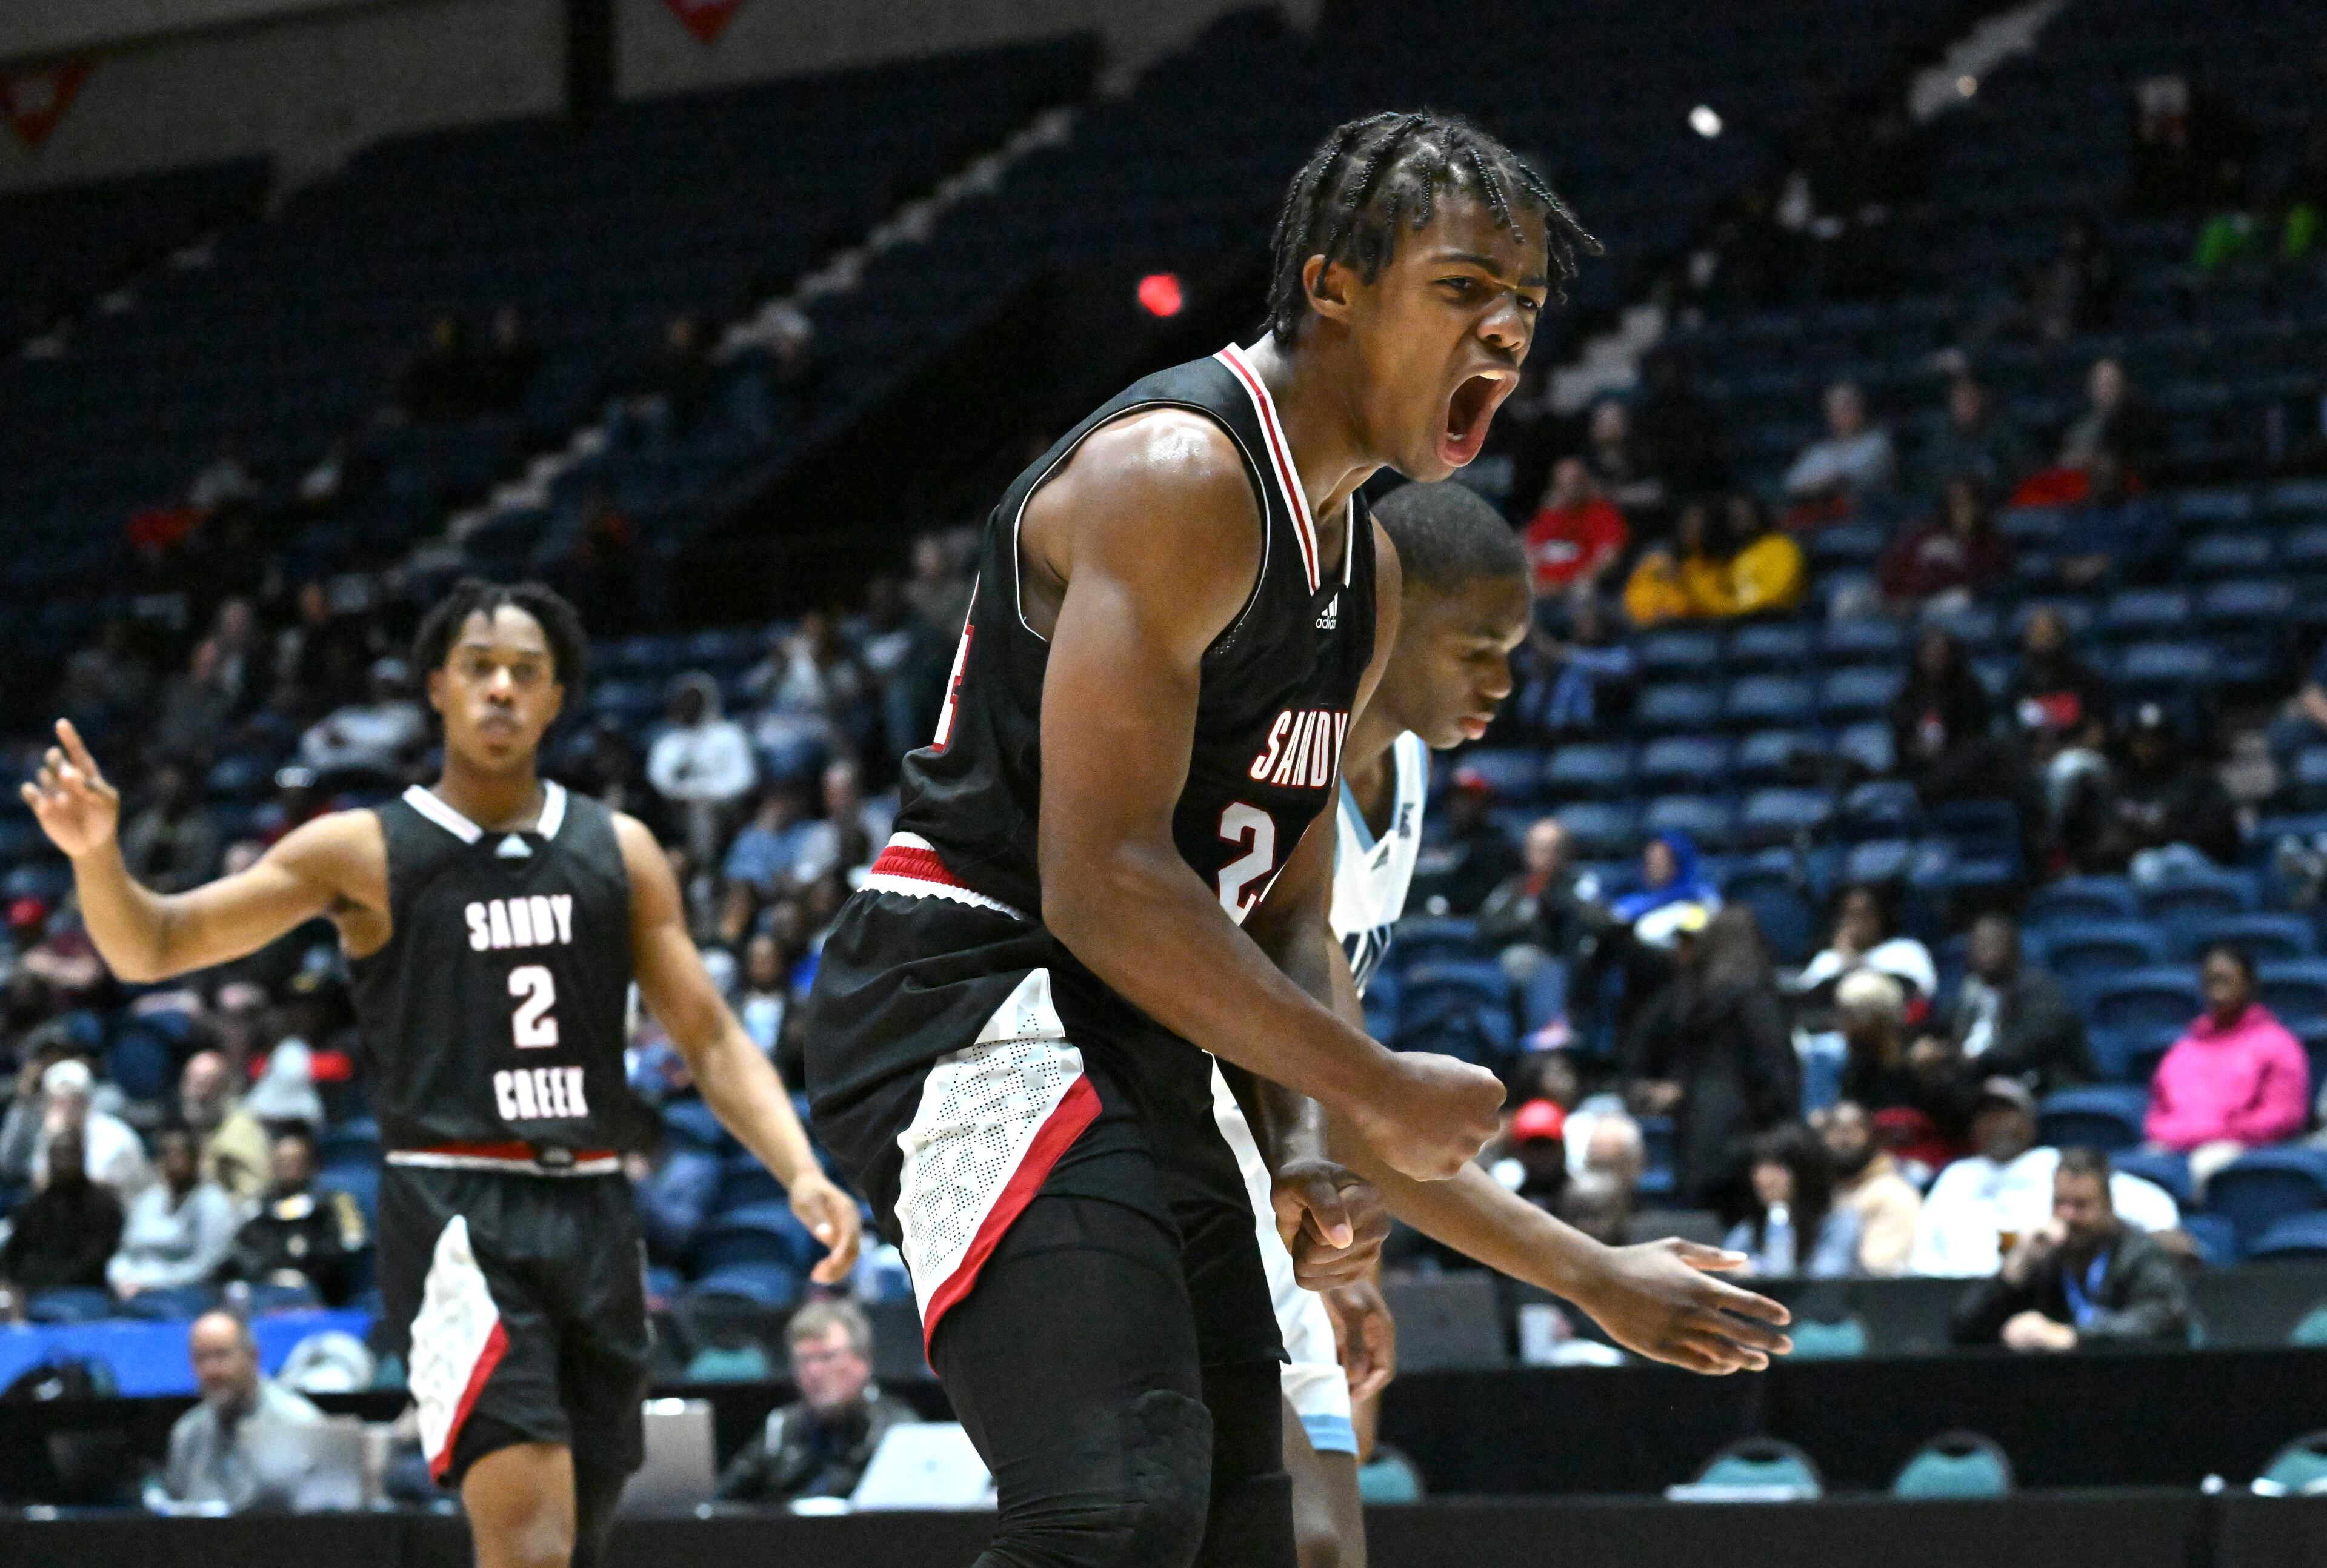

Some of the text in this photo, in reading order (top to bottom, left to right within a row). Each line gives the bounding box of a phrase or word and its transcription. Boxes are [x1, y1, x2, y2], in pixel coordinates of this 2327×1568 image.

[1248, 708, 1349, 788] SANDY
[464, 894, 573, 951] SANDY
[507, 965, 559, 1049] 2
[493, 1066, 589, 1121] CREEK
